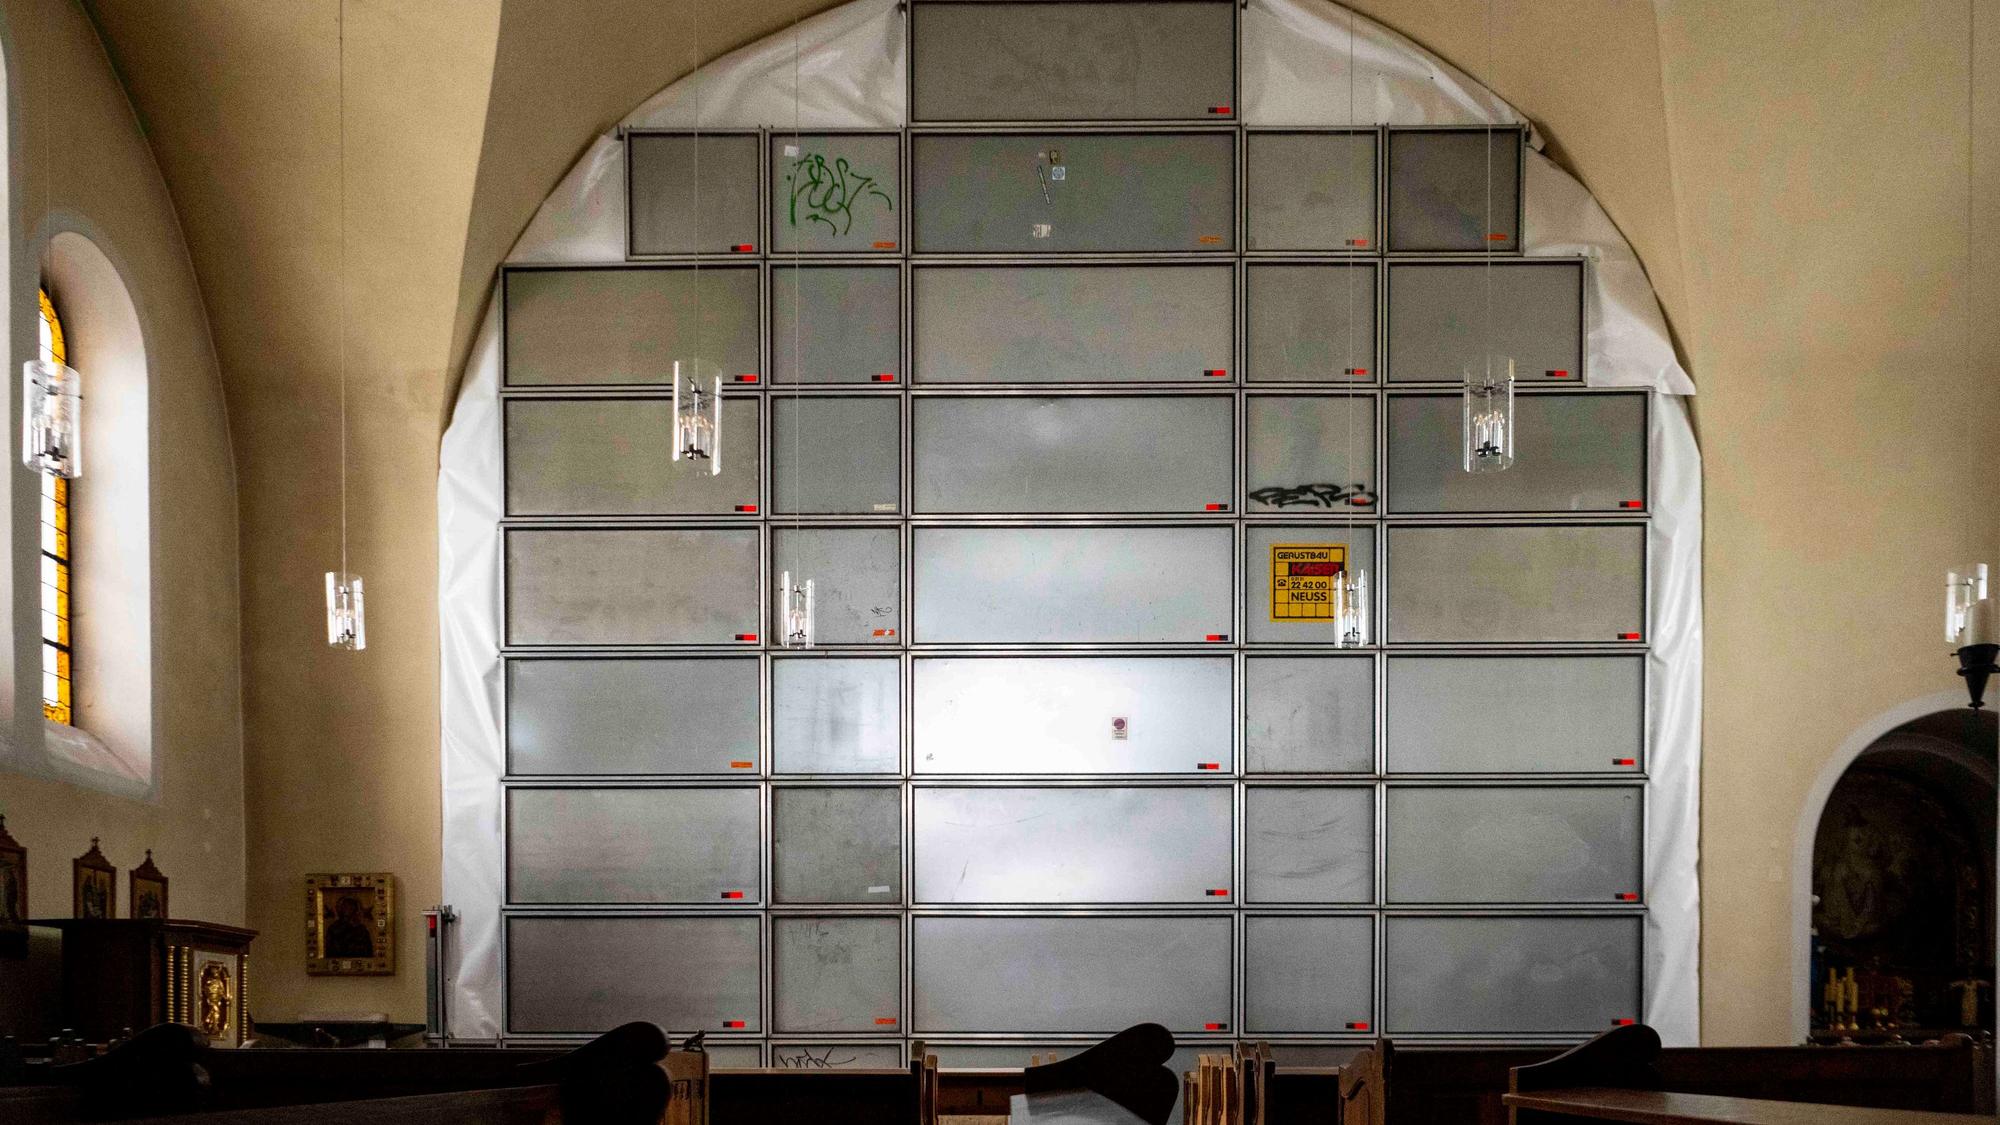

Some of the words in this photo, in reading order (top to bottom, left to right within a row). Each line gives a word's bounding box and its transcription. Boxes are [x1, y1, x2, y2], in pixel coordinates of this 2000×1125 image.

[1291, 581, 1301, 589] 22
[1302, 581, 1314, 589] 42
[1314, 581, 1327, 589] 00
[1291, 591, 1327, 601] NEUSS
